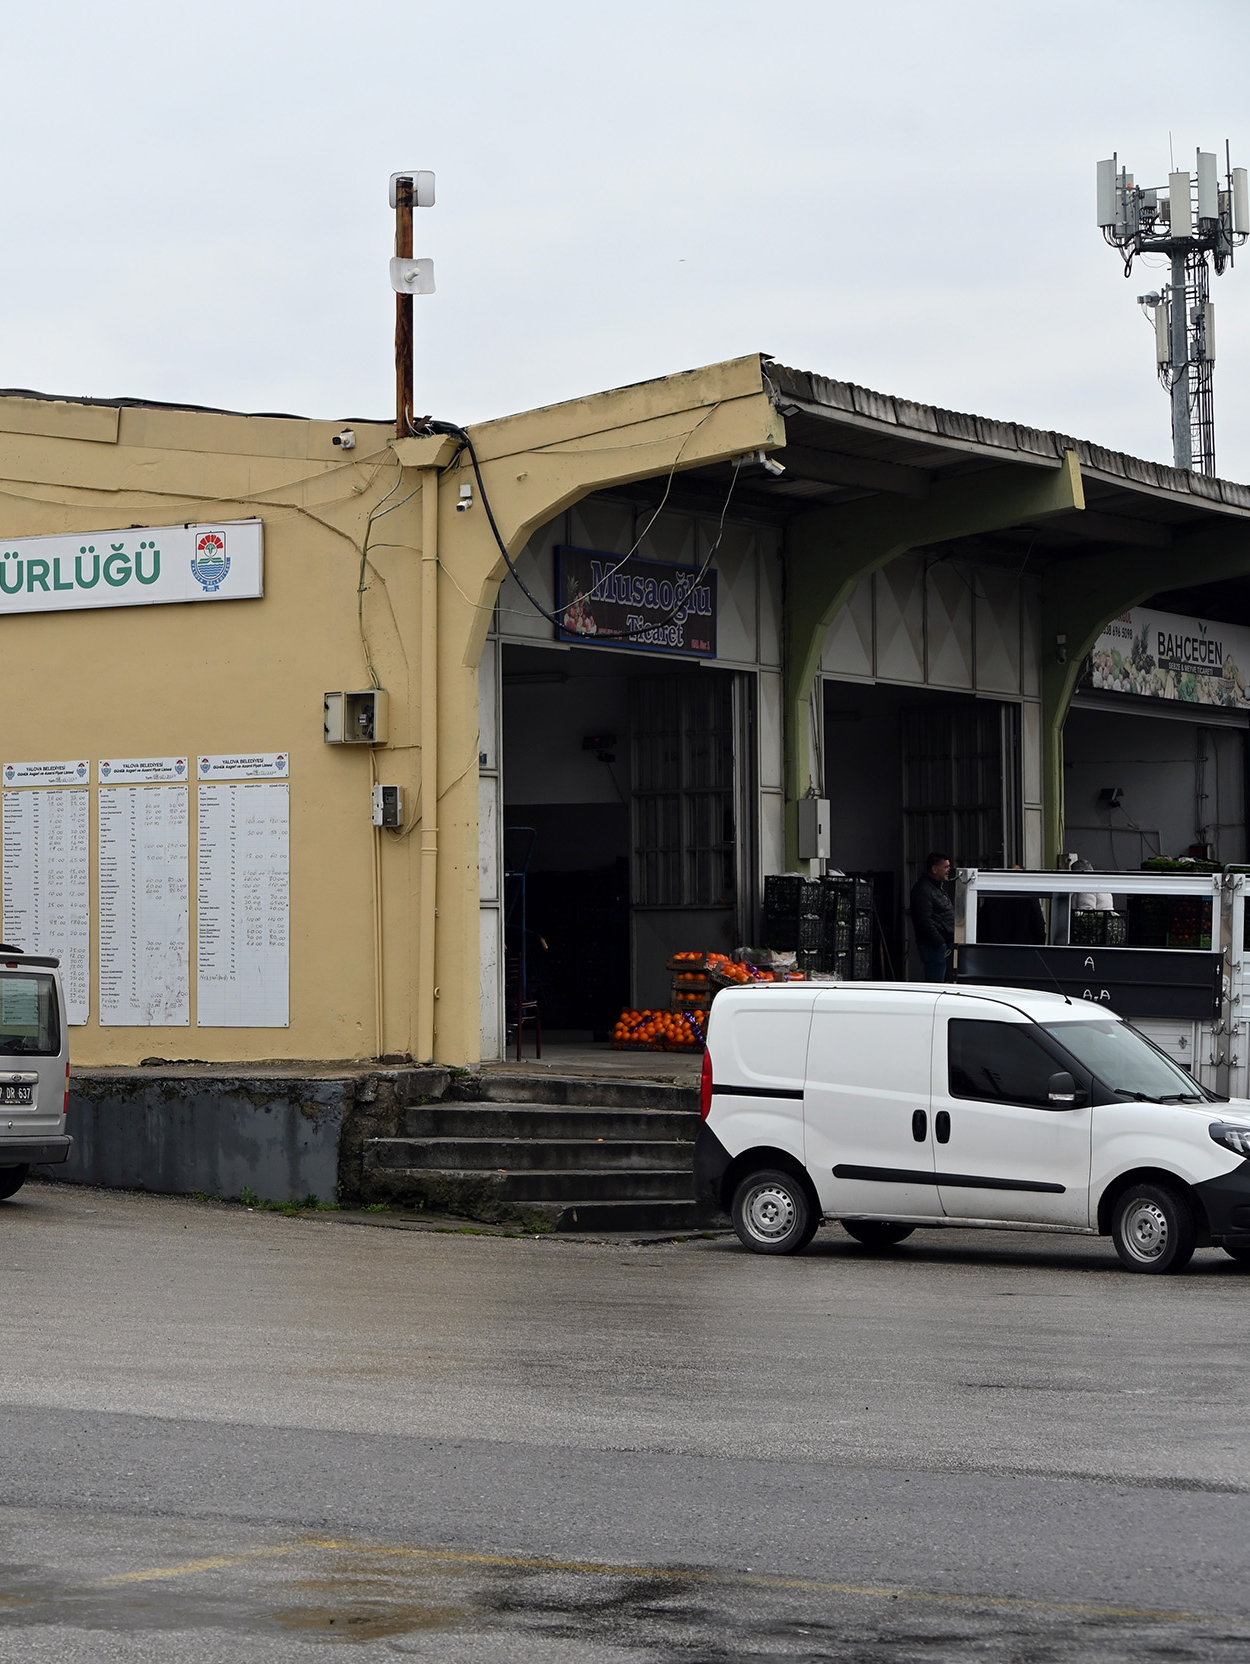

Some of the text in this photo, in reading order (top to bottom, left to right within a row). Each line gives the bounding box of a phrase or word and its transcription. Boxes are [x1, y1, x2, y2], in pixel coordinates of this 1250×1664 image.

[590, 560, 712, 624] Musaoğlu
[626, 614, 684, 647] Ticaret
[1084, 955, 1095, 972] A
[6, 1087, 16, 1099] DR
[18, 1087, 31, 1099] 637
